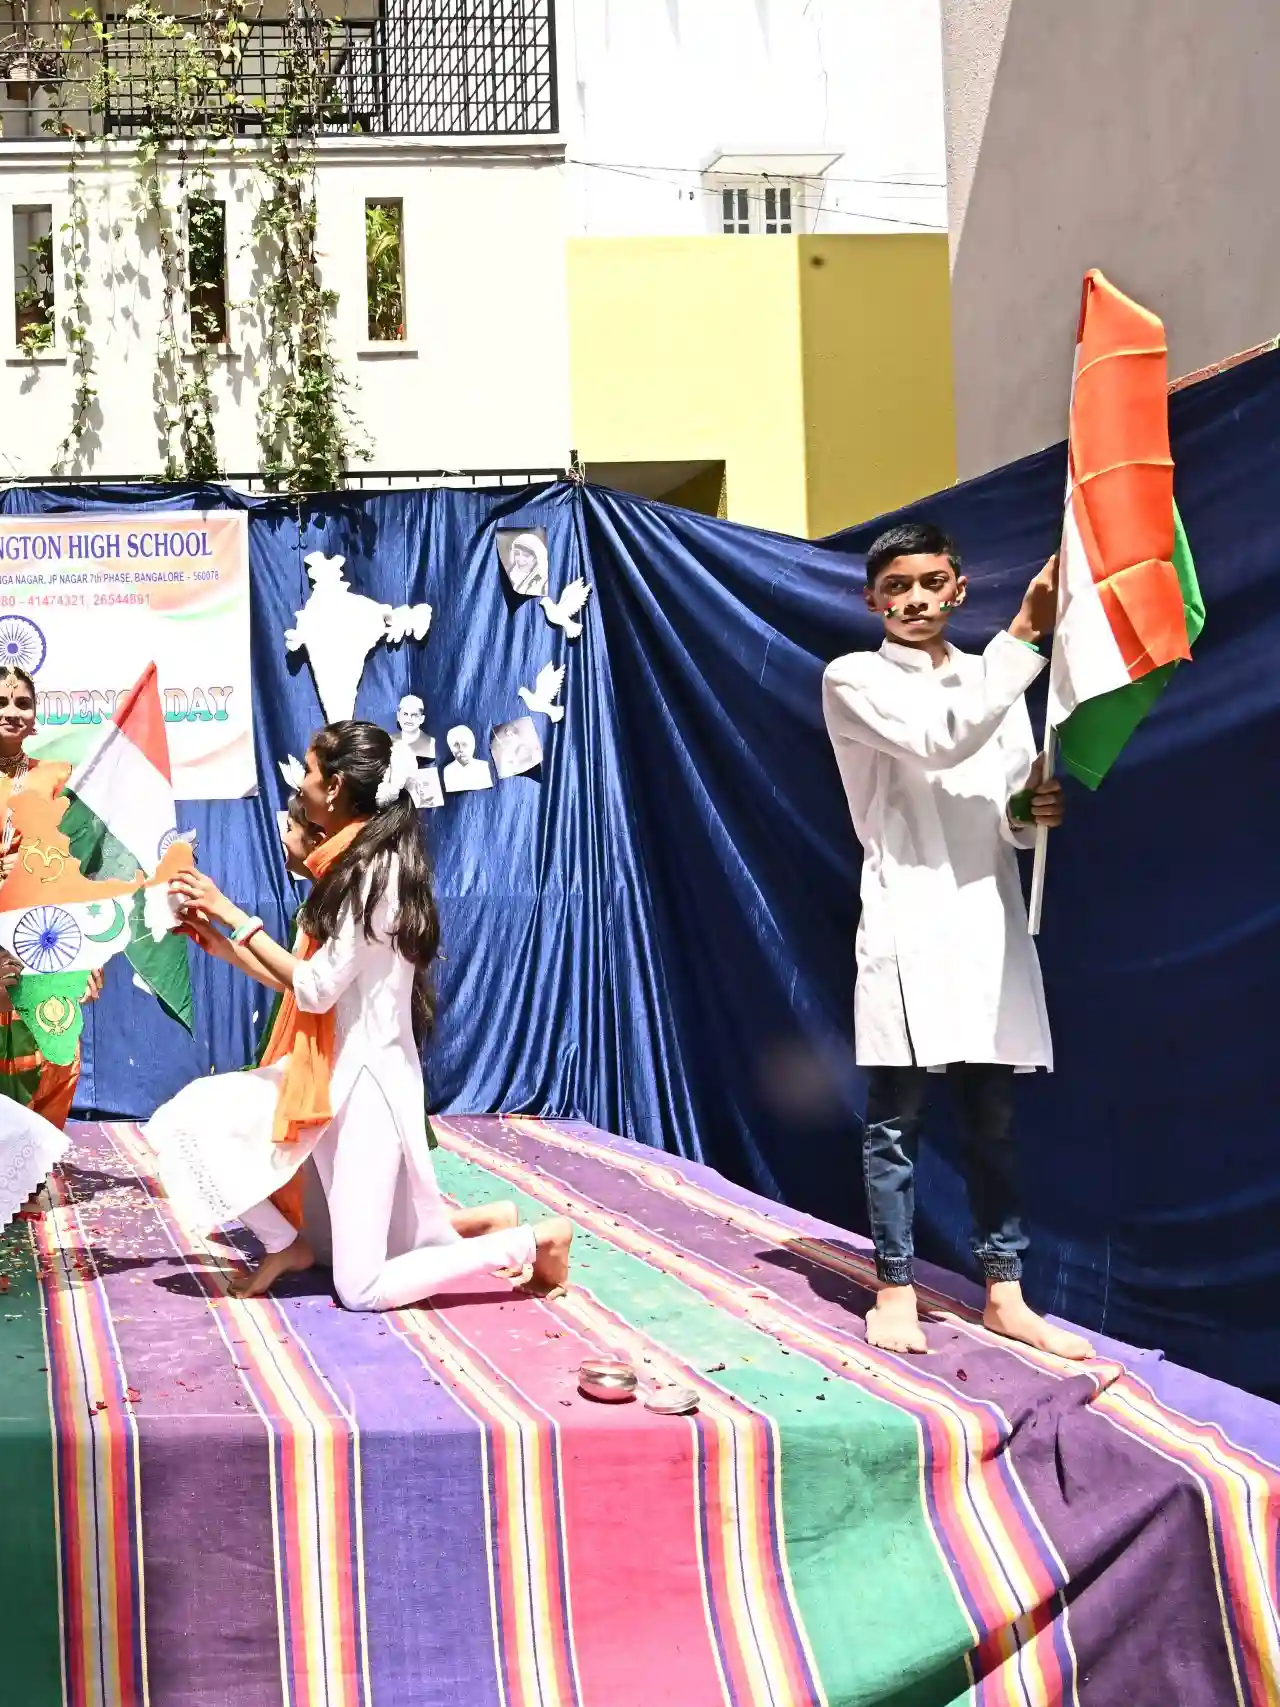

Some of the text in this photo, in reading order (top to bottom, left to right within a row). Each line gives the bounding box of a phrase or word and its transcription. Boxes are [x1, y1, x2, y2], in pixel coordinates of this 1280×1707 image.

[68, 533, 121, 559] HIGH
[127, 531, 213, 558] SCHOOL
[47, 574, 58, 585] JP
[134, 571, 185, 583] BANGALORE
[163, 686, 234, 722] DAY
